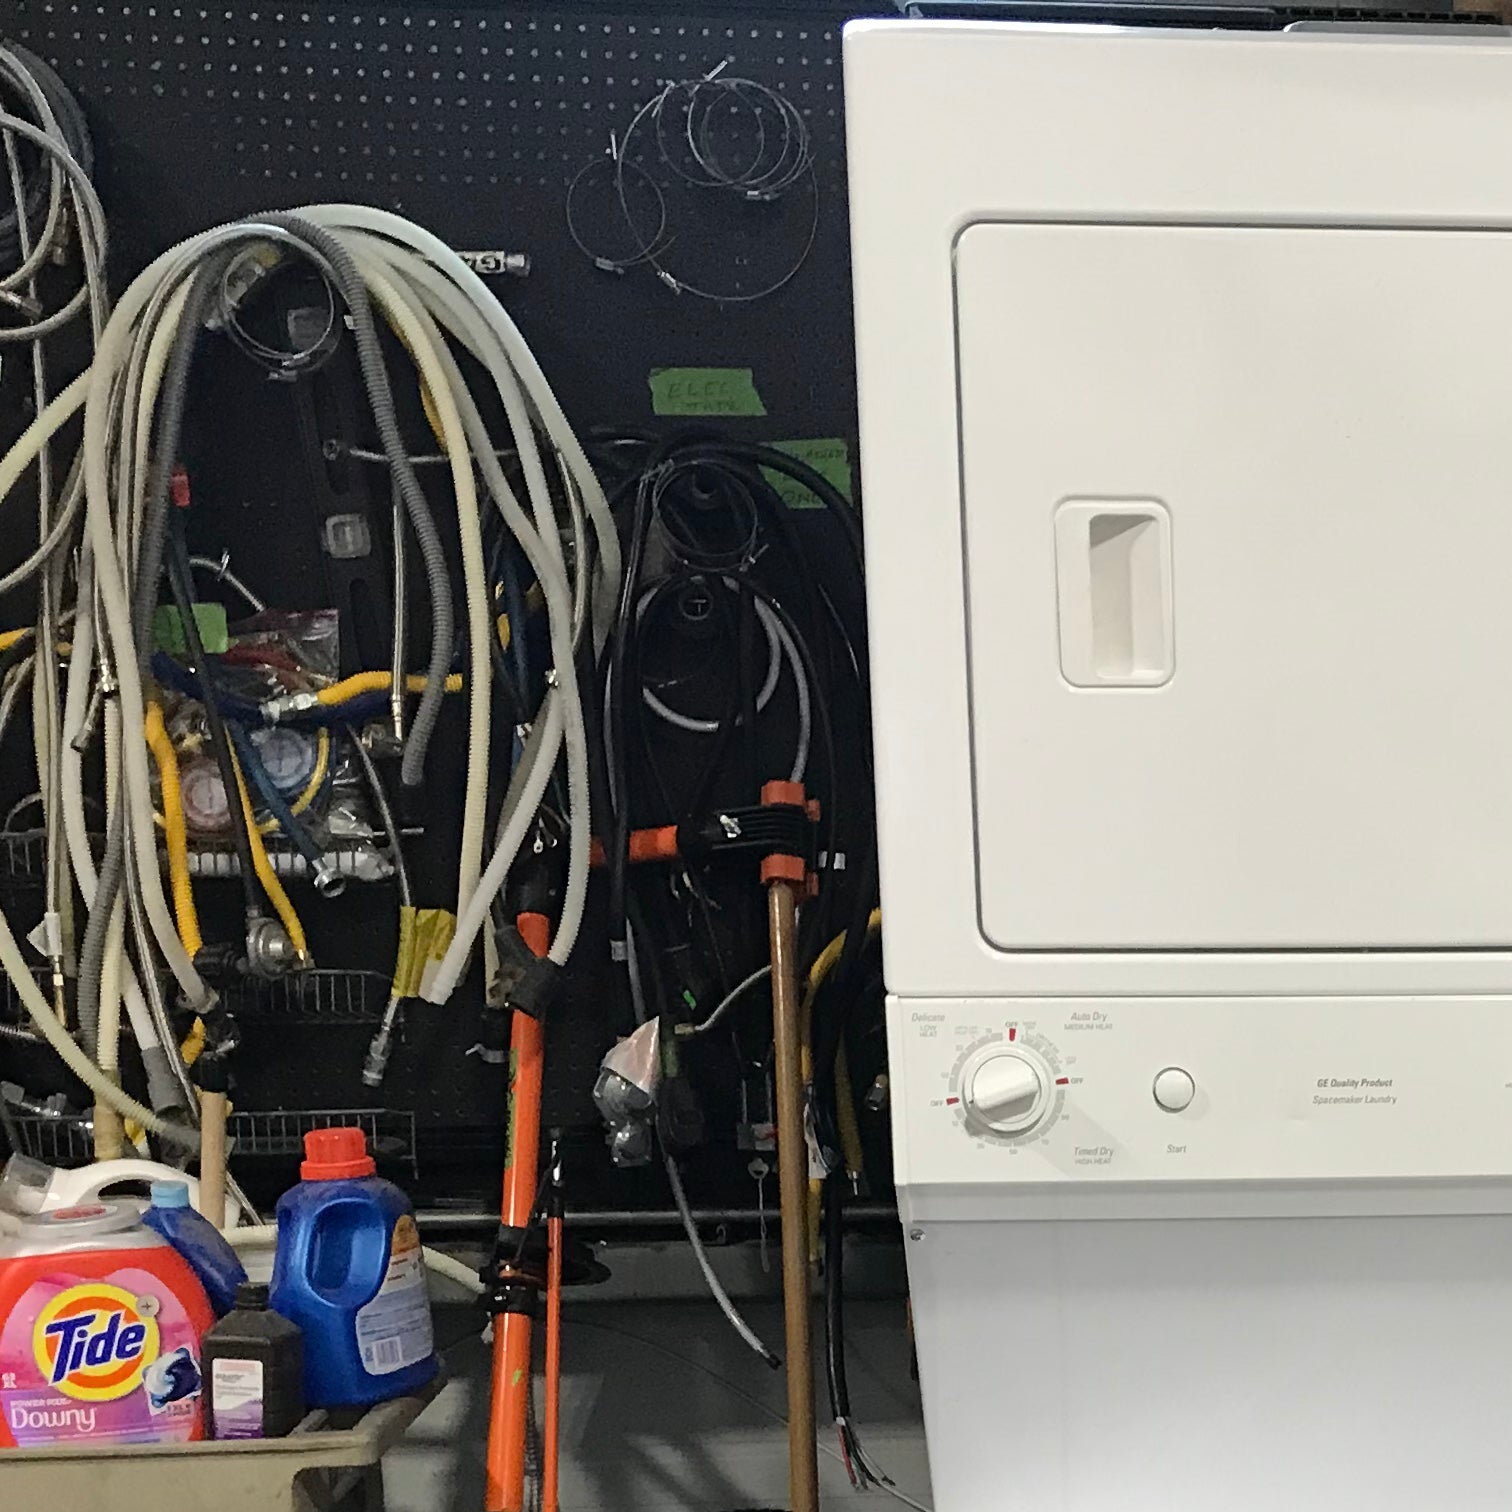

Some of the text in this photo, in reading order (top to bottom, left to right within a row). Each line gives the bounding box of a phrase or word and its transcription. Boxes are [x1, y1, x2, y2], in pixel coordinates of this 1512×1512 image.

[911, 1012, 945, 1022] Delicate
[1070, 1011, 1108, 1022] Auto Dry
[1317, 1078, 1393, 1089] GE Quality Product
[1312, 1094, 1398, 1105] Spacemaker Laundry
[1074, 1147, 1114, 1157] Timed Dry
[1166, 1143, 1187, 1153] Start
[45, 1312, 146, 1383] Tide
[11, 1407, 96, 1432] Downy
